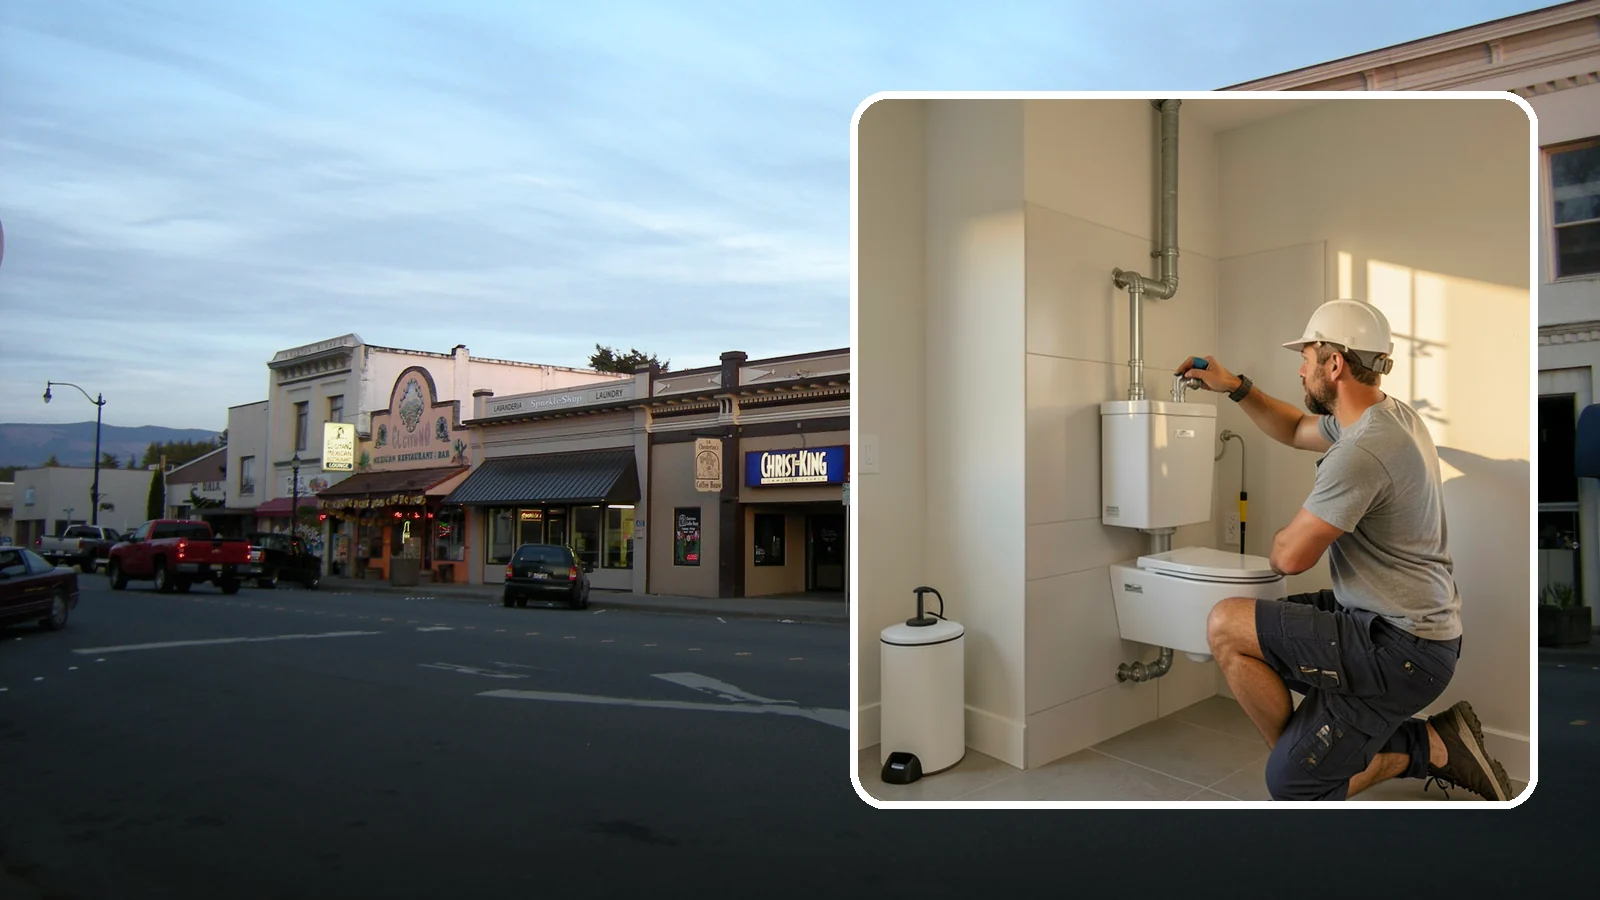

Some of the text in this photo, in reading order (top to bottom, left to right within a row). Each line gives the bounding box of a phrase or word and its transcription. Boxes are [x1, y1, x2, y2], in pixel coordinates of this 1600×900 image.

[595, 389, 623, 400] LAUNDRY
[493, 402, 522, 412] LAVANDERIA
[530, 394, 583, 409] Sparkle Shop
[397, 451, 433, 463] RESTAURANT
[438, 450, 450, 459] BAR
[761, 450, 827, 477] CHRIST KING
